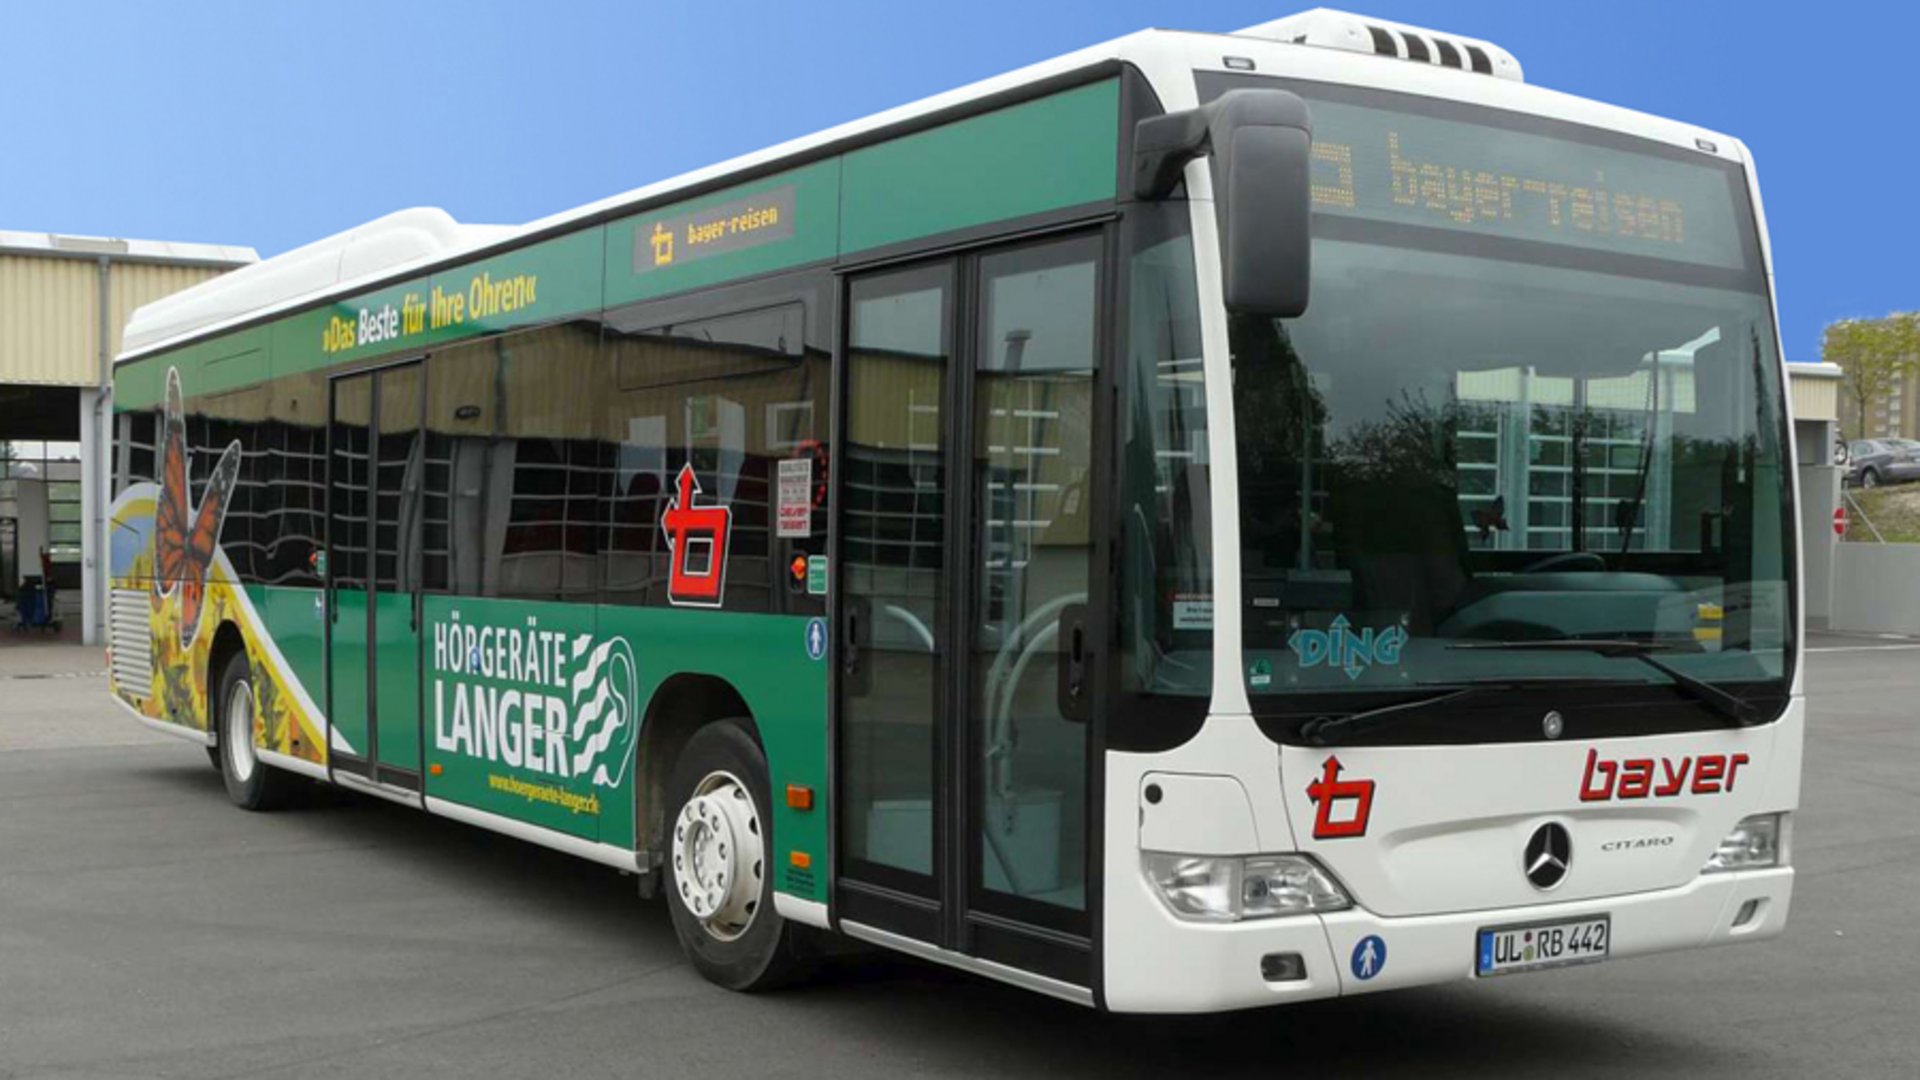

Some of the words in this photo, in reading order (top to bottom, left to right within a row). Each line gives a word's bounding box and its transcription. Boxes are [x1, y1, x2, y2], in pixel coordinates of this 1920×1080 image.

[1389, 131, 1685, 244] bayer-reisen
[687, 207, 778, 245] bayer-reisen
[358, 304, 399, 346] Beste
[403, 293, 427, 336] für
[431, 285, 465, 330] Ihre
[469, 271, 537, 320] Ohren«
[434, 610, 567, 688] HÖRGERÄTE
[1297, 622, 1408, 670] DING
[434, 679, 570, 778] LANGER
[1579, 748, 1750, 802] bayer
[1600, 835, 1675, 852] CITARO
[1494, 934, 1523, 964] UL
[1536, 928, 1565, 959] RB
[1567, 923, 1606, 955] 442
